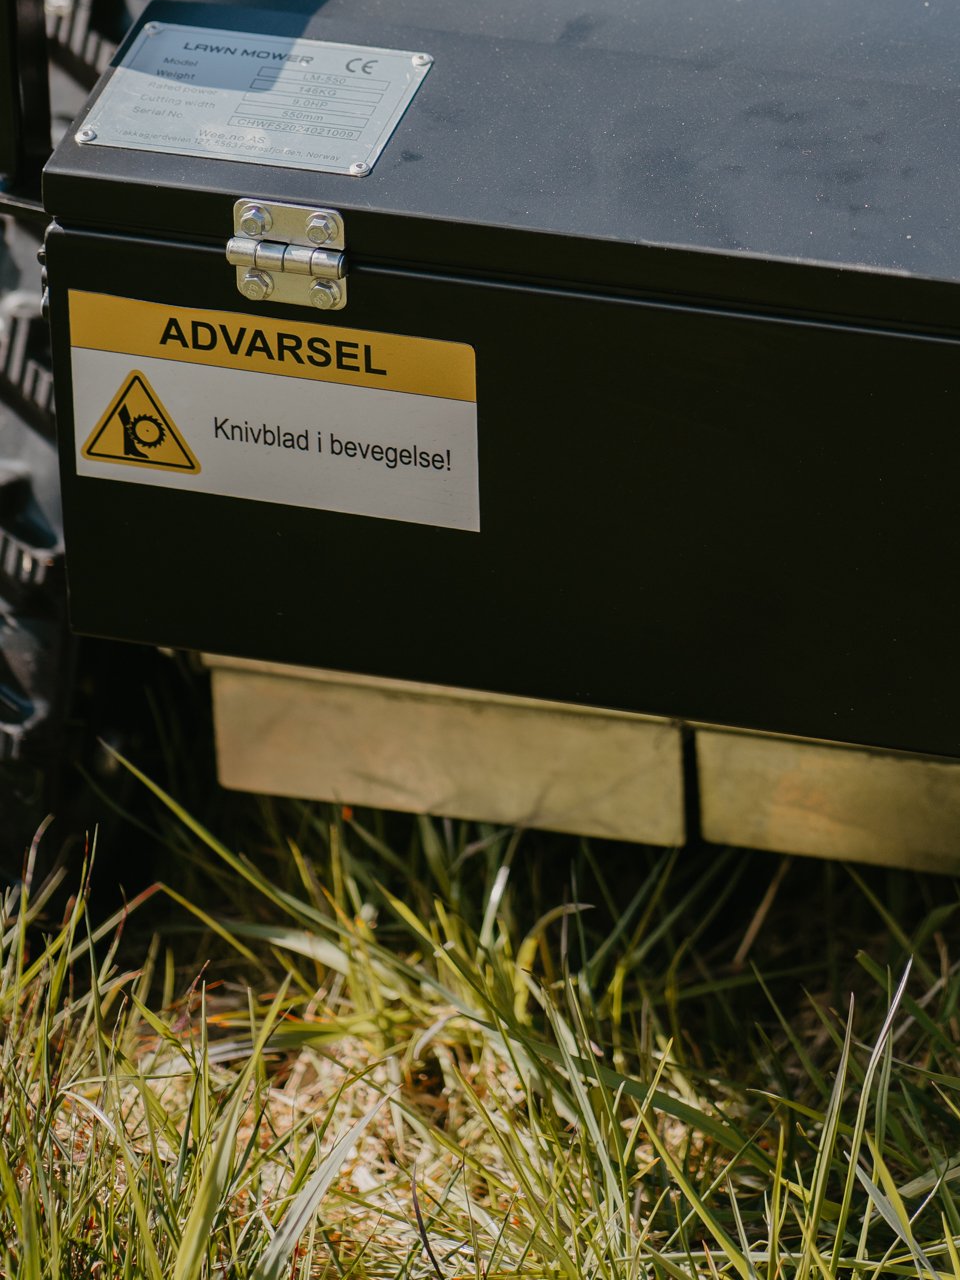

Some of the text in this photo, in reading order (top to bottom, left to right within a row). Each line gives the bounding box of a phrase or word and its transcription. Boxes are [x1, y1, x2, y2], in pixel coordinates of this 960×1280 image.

[183, 42, 314, 64] LAWN MOWER
[163, 57, 198, 67] Model
[345, 57, 379, 75] CE
[156, 69, 196, 80] Weight
[140, 94, 216, 109] Cutting width
[132, 106, 166, 116] Serial
[159, 317, 387, 376] ADVARSEL
[213, 416, 451, 472] Knivblad i bevegelse!
